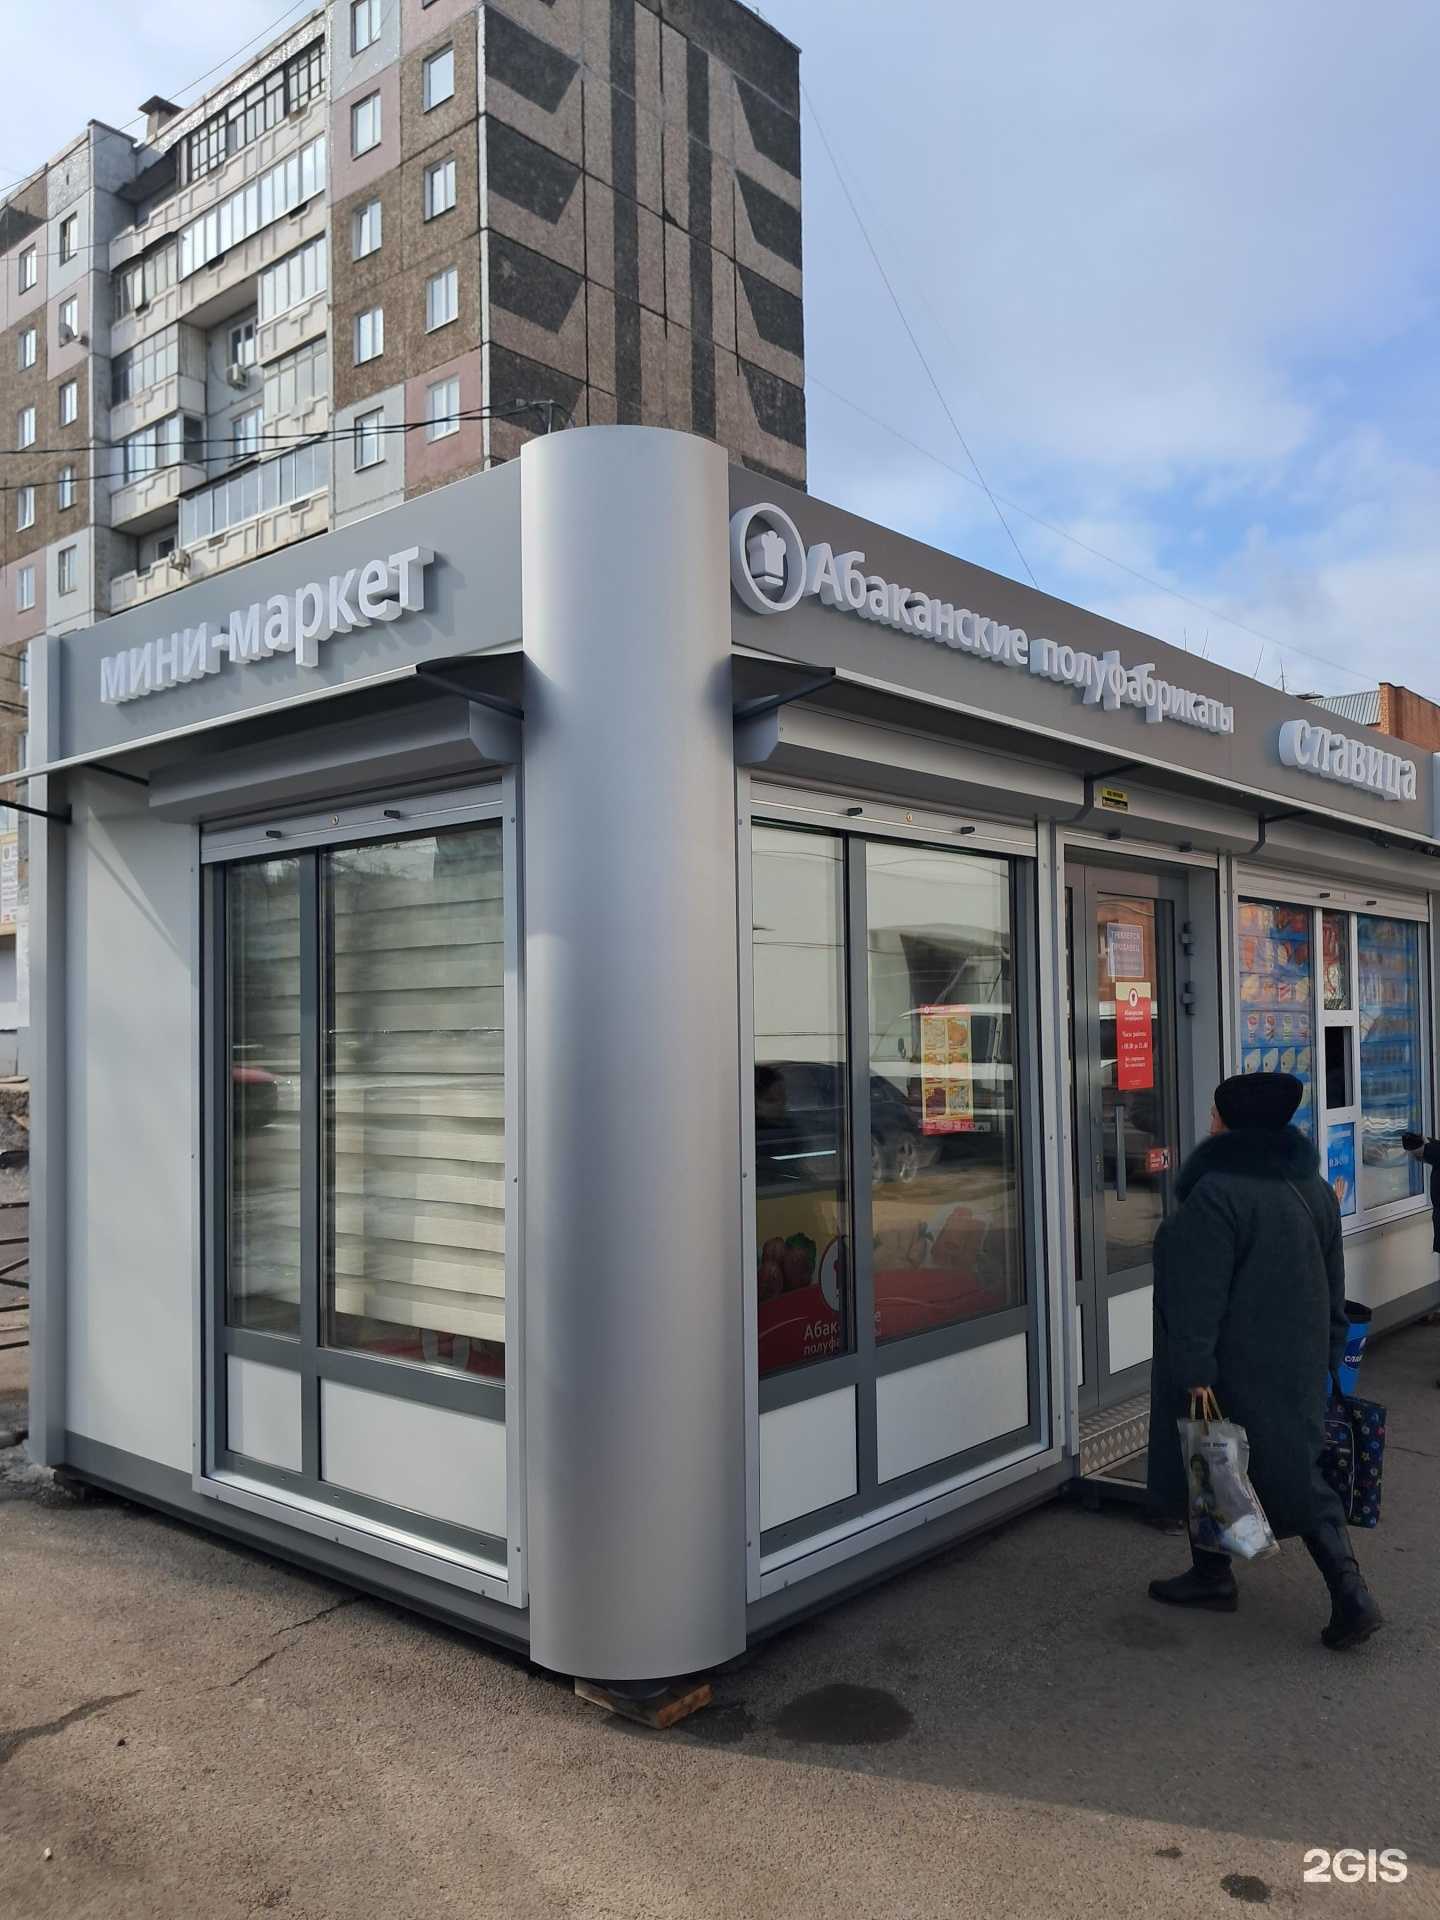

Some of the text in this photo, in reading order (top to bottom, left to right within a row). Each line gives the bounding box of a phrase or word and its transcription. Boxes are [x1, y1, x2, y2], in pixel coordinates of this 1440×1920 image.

[100, 545, 434, 705] мини-маркет
[805, 542, 1235, 736] Абаканские полуфабрикаты
[1279, 718, 1417, 801] Славица
[803, 1319, 840, 1341] Абак
